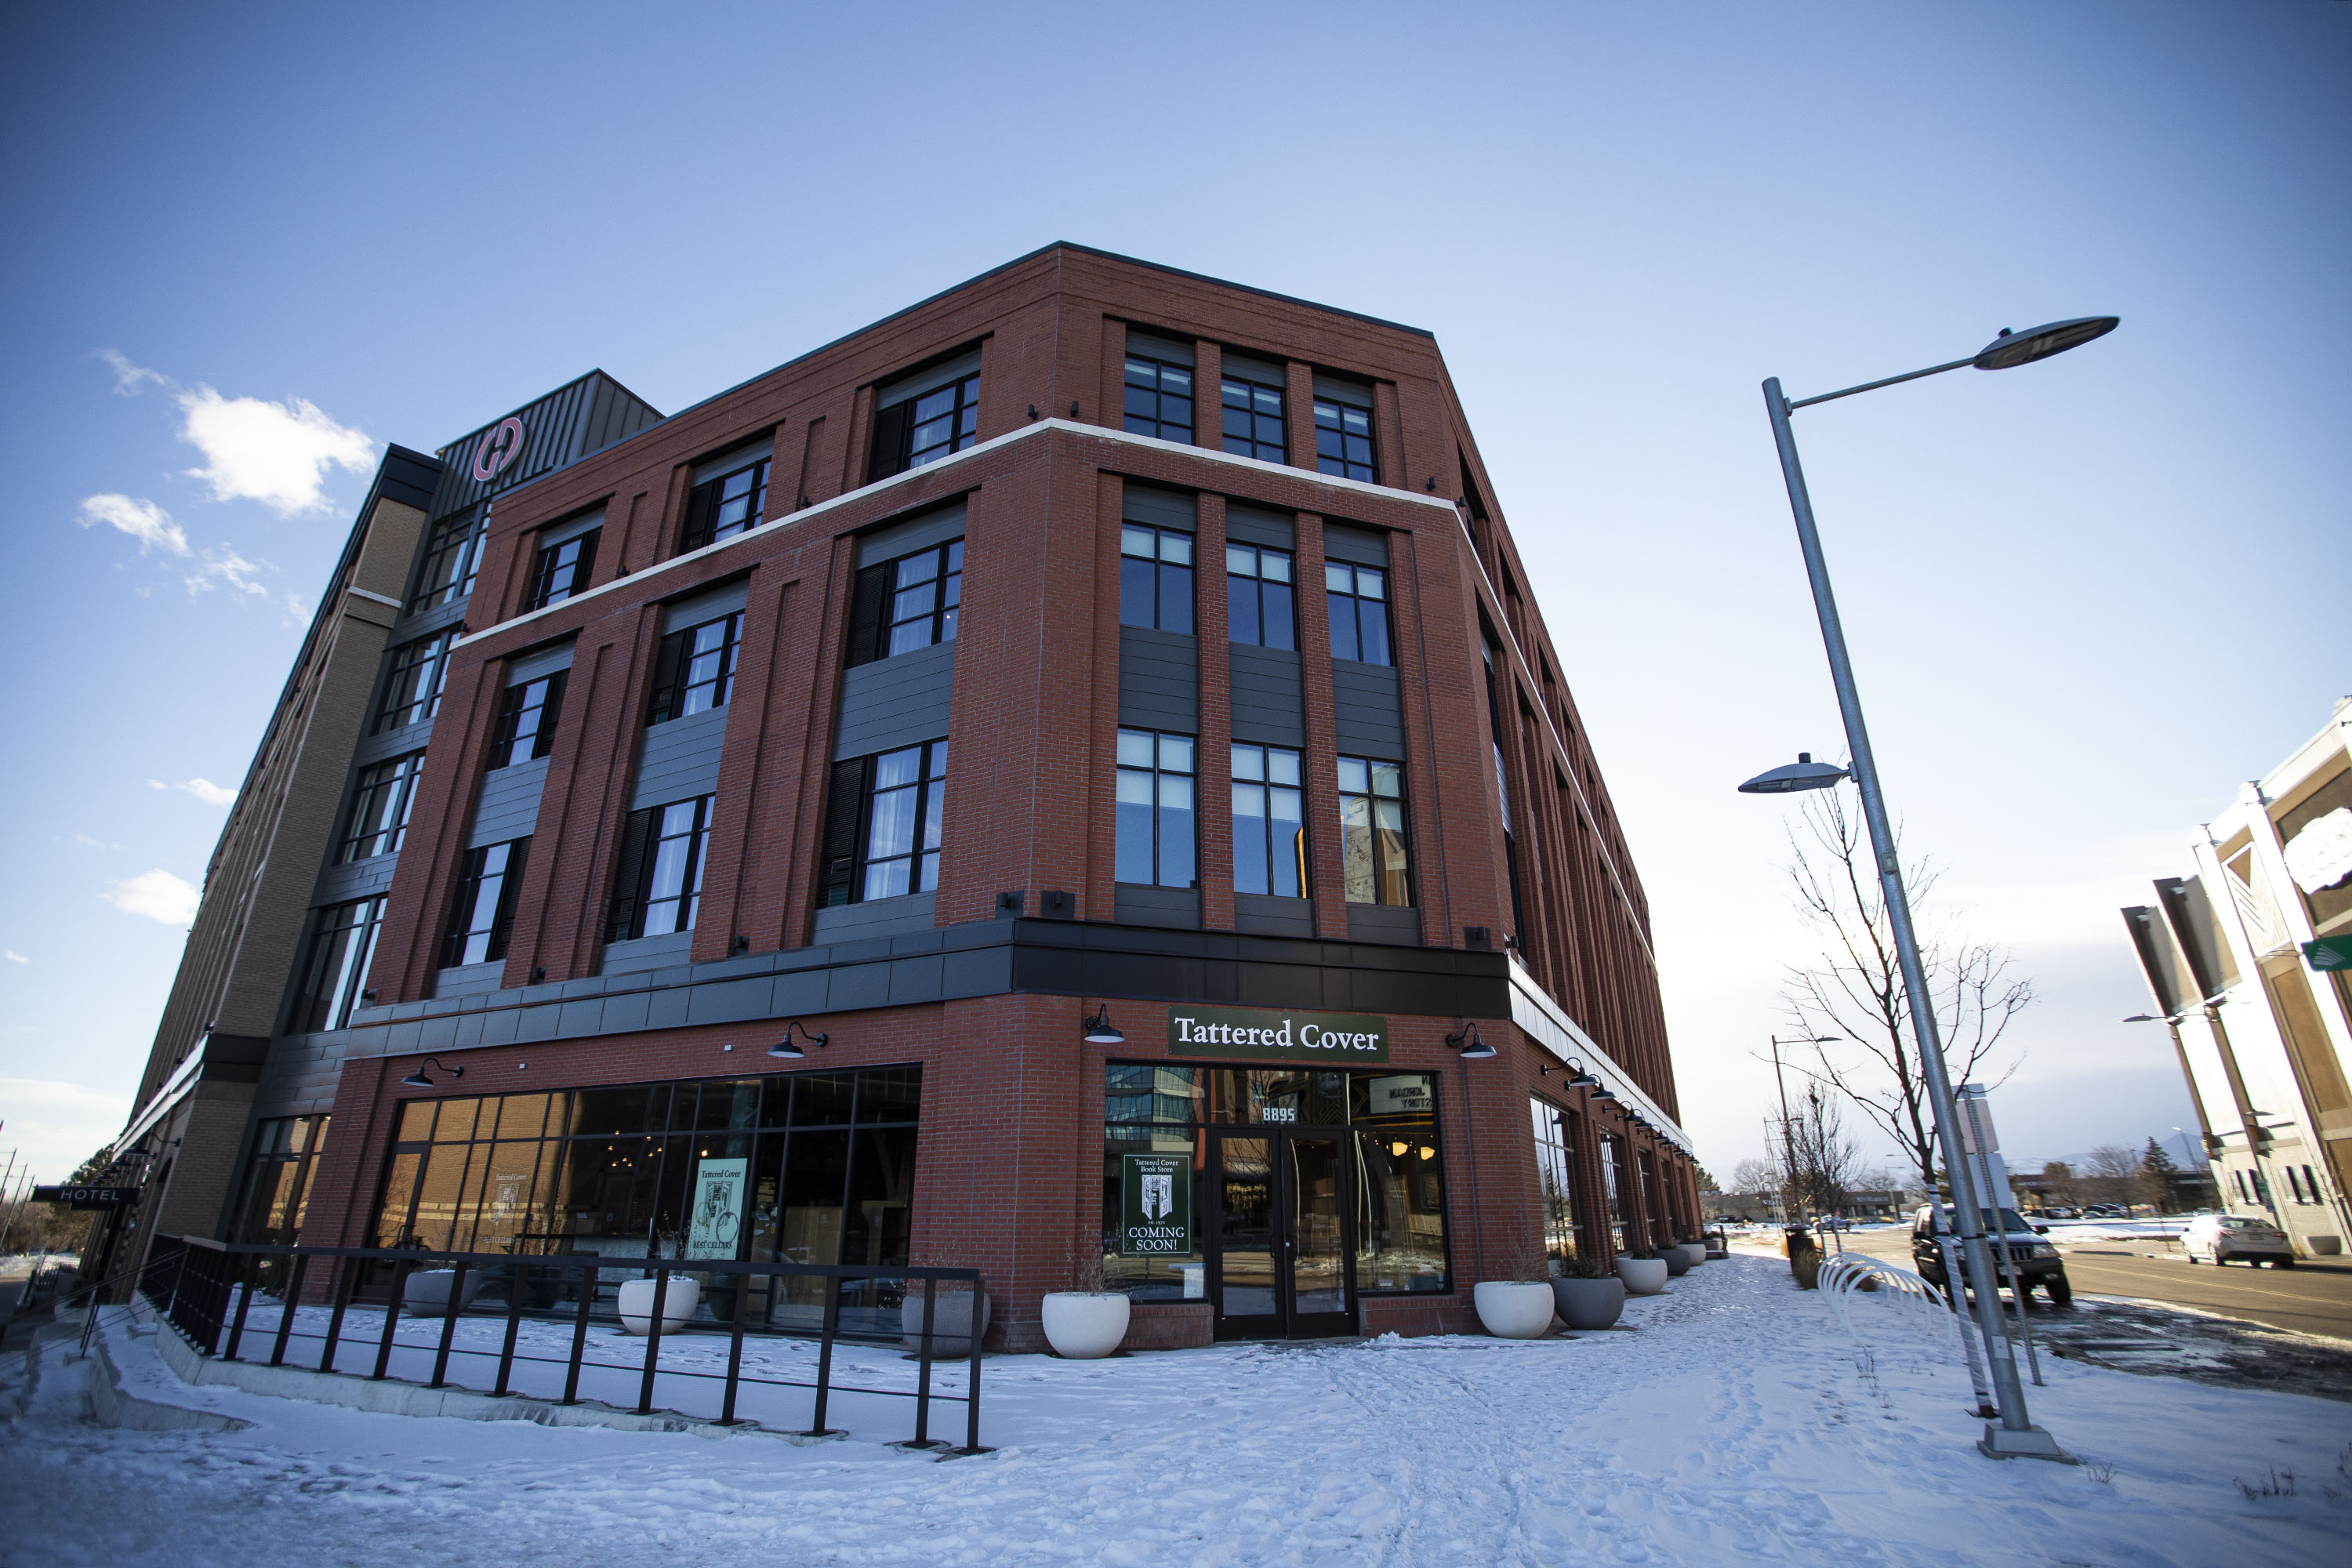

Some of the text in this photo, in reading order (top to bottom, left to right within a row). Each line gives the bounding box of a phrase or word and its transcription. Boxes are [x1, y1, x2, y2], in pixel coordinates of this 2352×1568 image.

[1174, 1017, 1379, 1051] Tattered Cover
[1262, 1107, 1295, 1121] 8895
[702, 1169, 724, 1178] Tattered
[60, 1189, 120, 1200] HOTEL
[1128, 1226, 1185, 1238] COMING
[1136, 1239, 1178, 1250] SOON!
